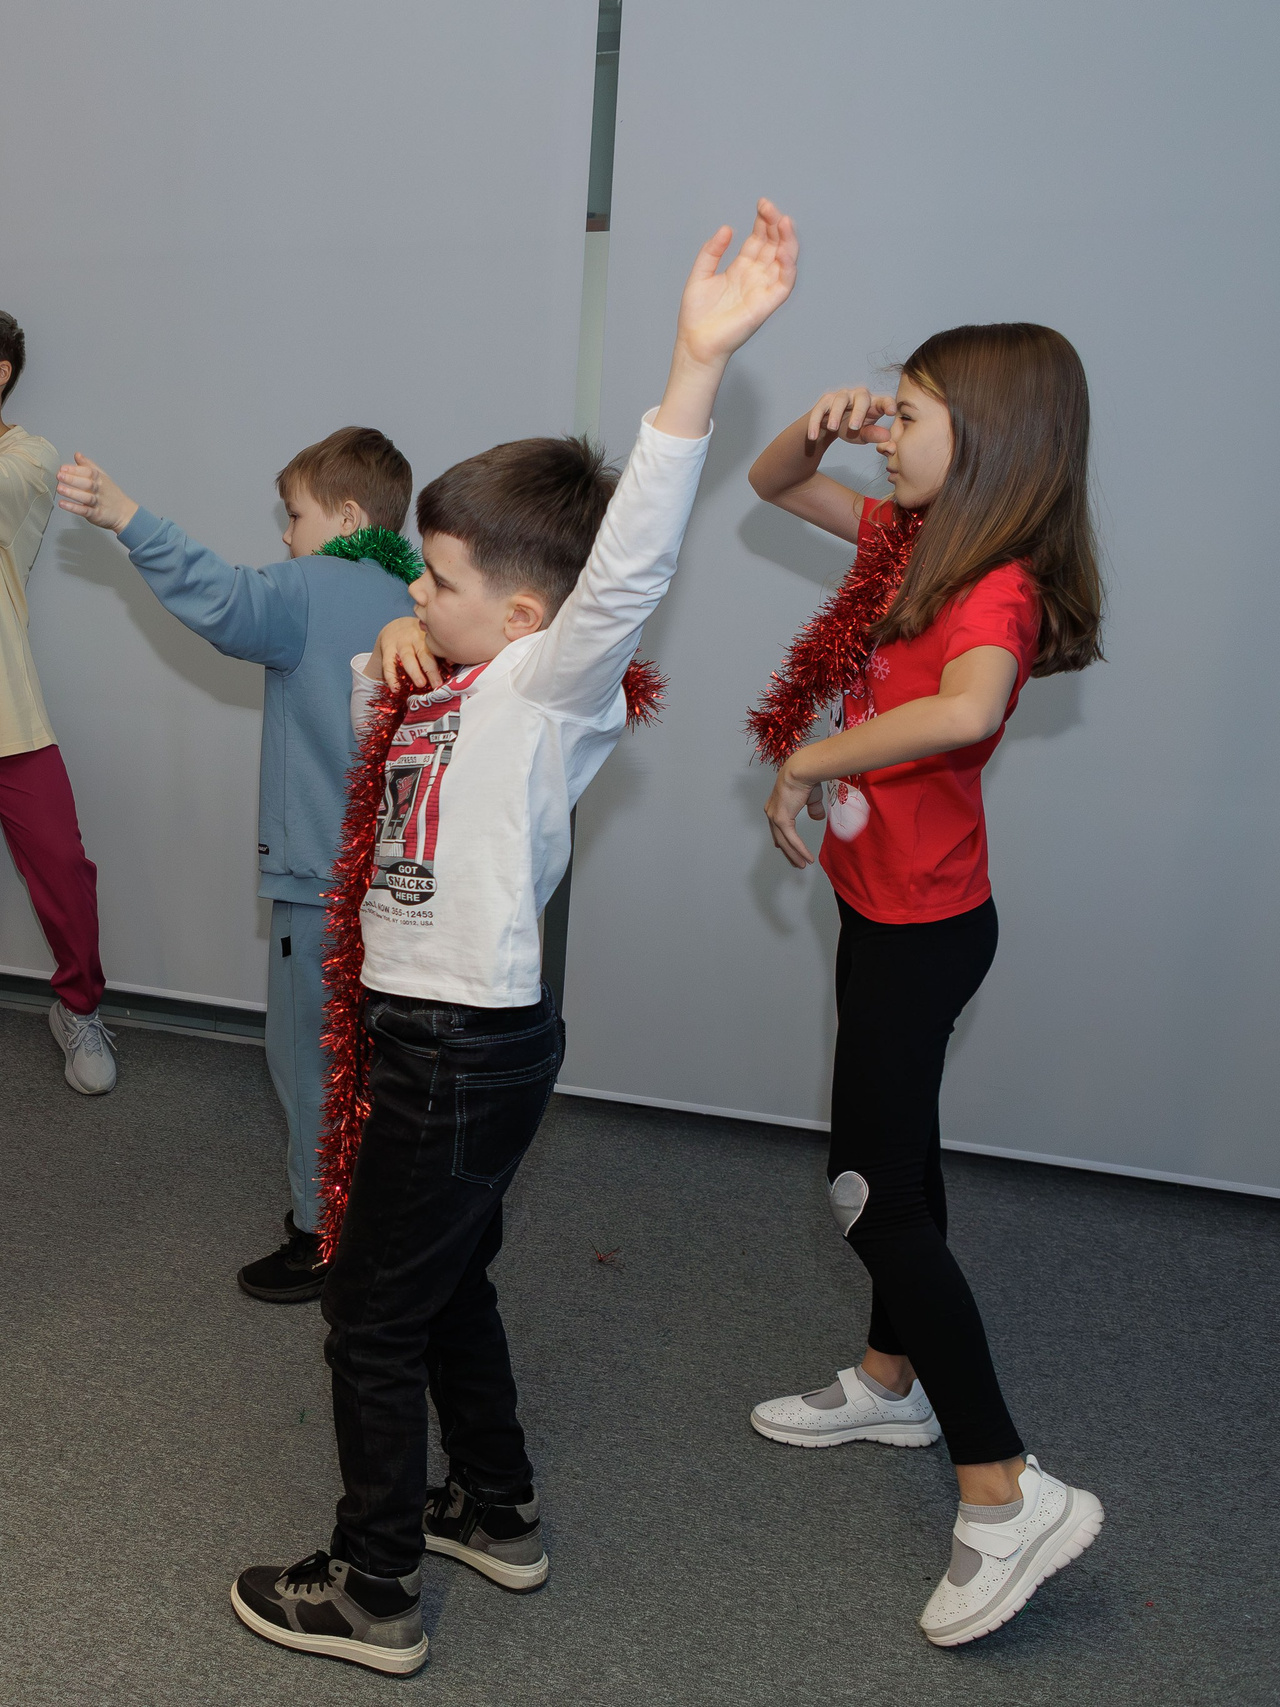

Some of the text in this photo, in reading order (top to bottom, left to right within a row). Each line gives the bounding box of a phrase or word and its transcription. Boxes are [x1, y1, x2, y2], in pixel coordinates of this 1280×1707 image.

[398, 865, 418, 875] GOT
[388, 875, 434, 891] SNACKS
[395, 891, 421, 902] HERE
